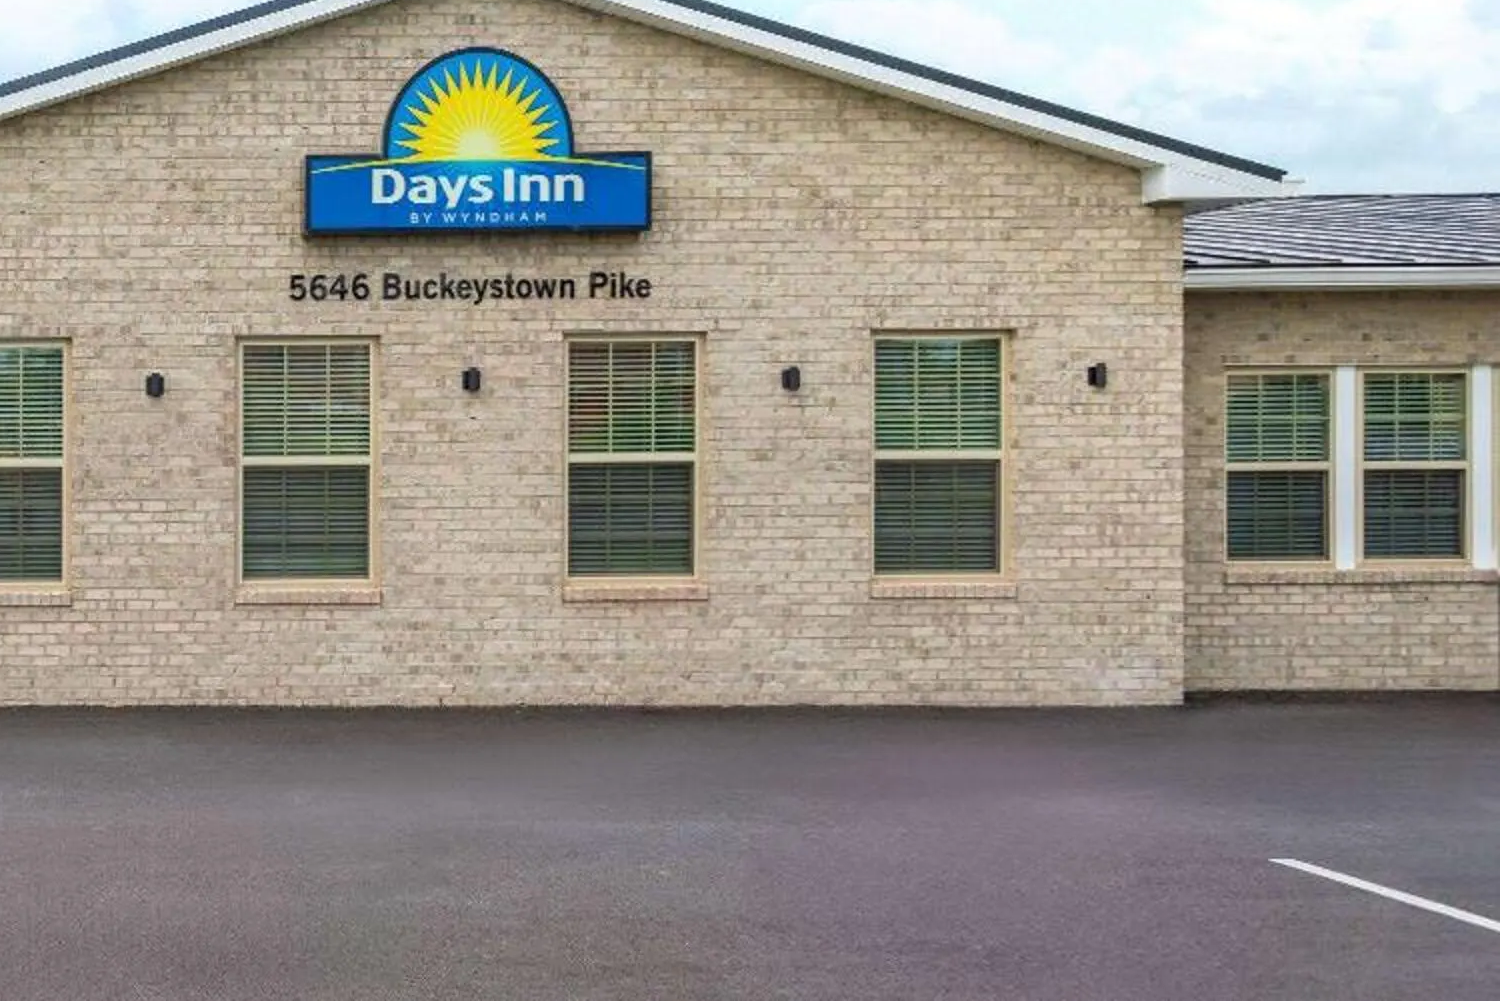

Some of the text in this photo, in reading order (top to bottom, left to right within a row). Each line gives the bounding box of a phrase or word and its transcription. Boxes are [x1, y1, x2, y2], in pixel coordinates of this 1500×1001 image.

[370, 168, 585, 209] Days Inn
[409, 211, 548, 225] BY WYNDHAM
[289, 271, 652, 305] 5646 Buckeystown Pike
